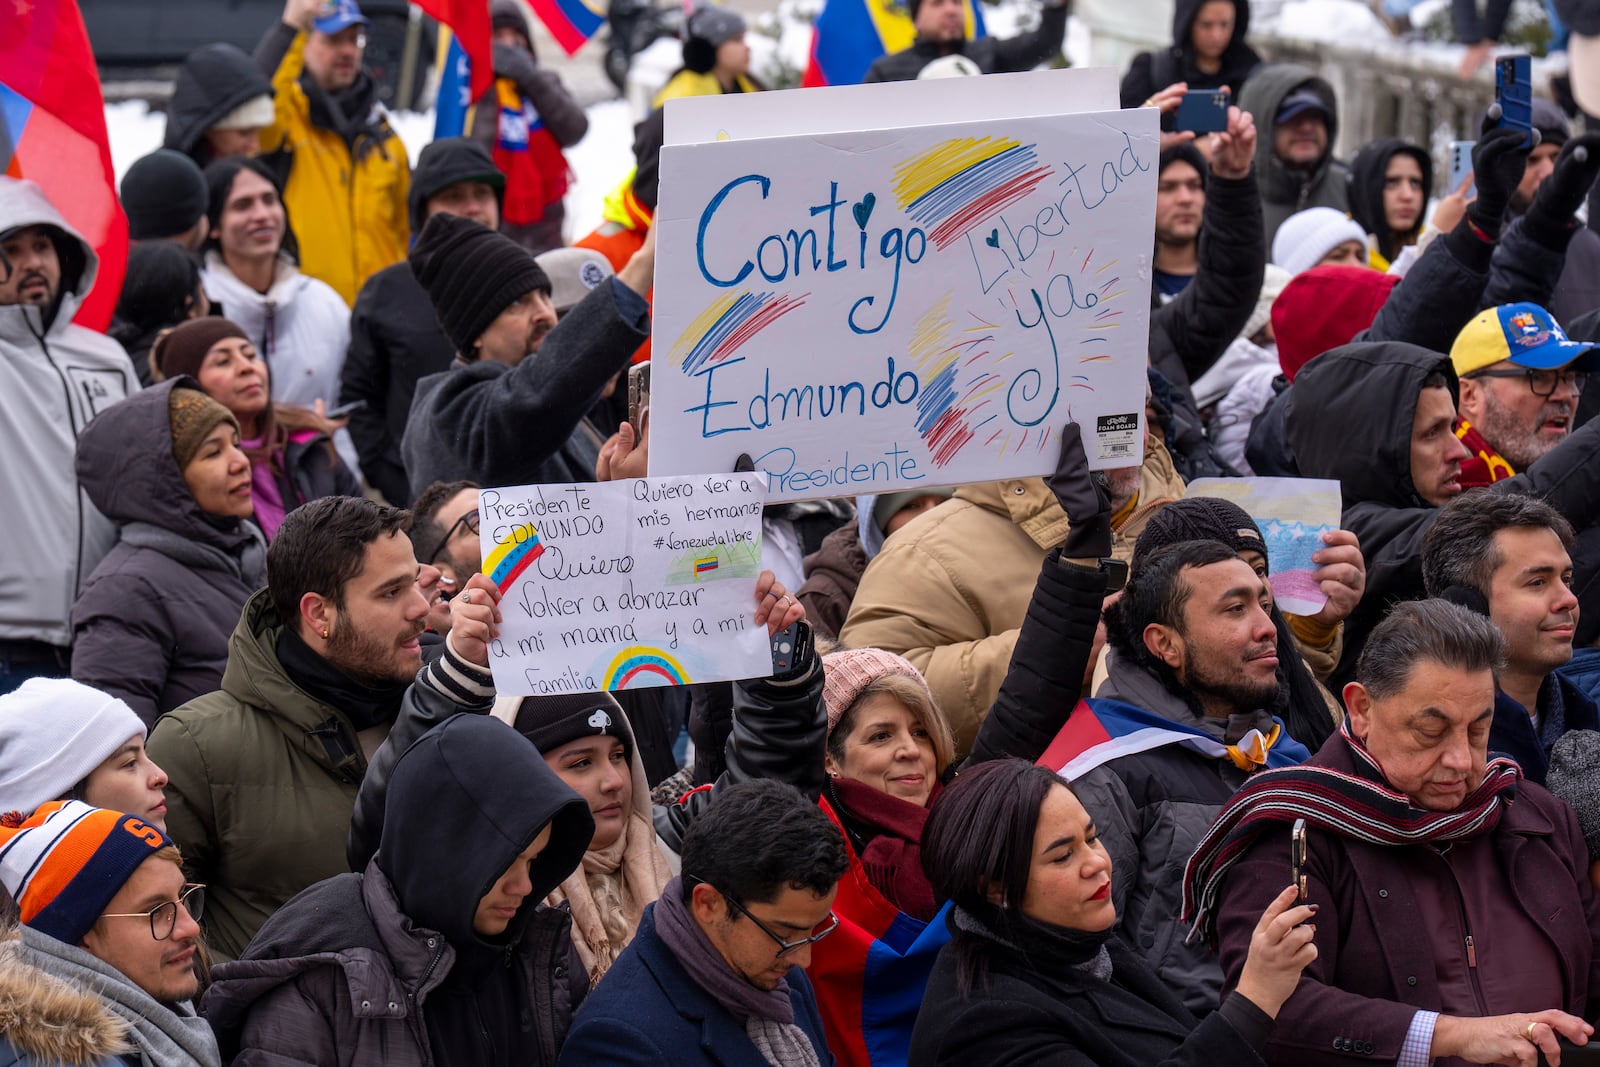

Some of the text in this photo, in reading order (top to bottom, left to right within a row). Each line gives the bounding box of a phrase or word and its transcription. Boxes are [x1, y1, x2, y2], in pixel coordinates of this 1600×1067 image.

[965, 131, 1150, 294] Libertad
[696, 174, 926, 334] Contigo
[1007, 274, 1098, 427] ya
[683, 356, 919, 438] Edmundo
[753, 442, 926, 493] Presidente
[481, 486, 590, 520] Presidente
[634, 480, 693, 502] Quiero
[740, 480, 751, 492] a
[493, 515, 603, 545] EDMUNDO
[637, 502, 760, 528] mis hermanos
[537, 545, 634, 580] Quiero
[593, 595, 608, 612] a
[618, 579, 704, 610] abrazar
[491, 614, 744, 657] a mi mamá y a mi
[525, 665, 597, 694] Familia
[123, 818, 164, 848] S
